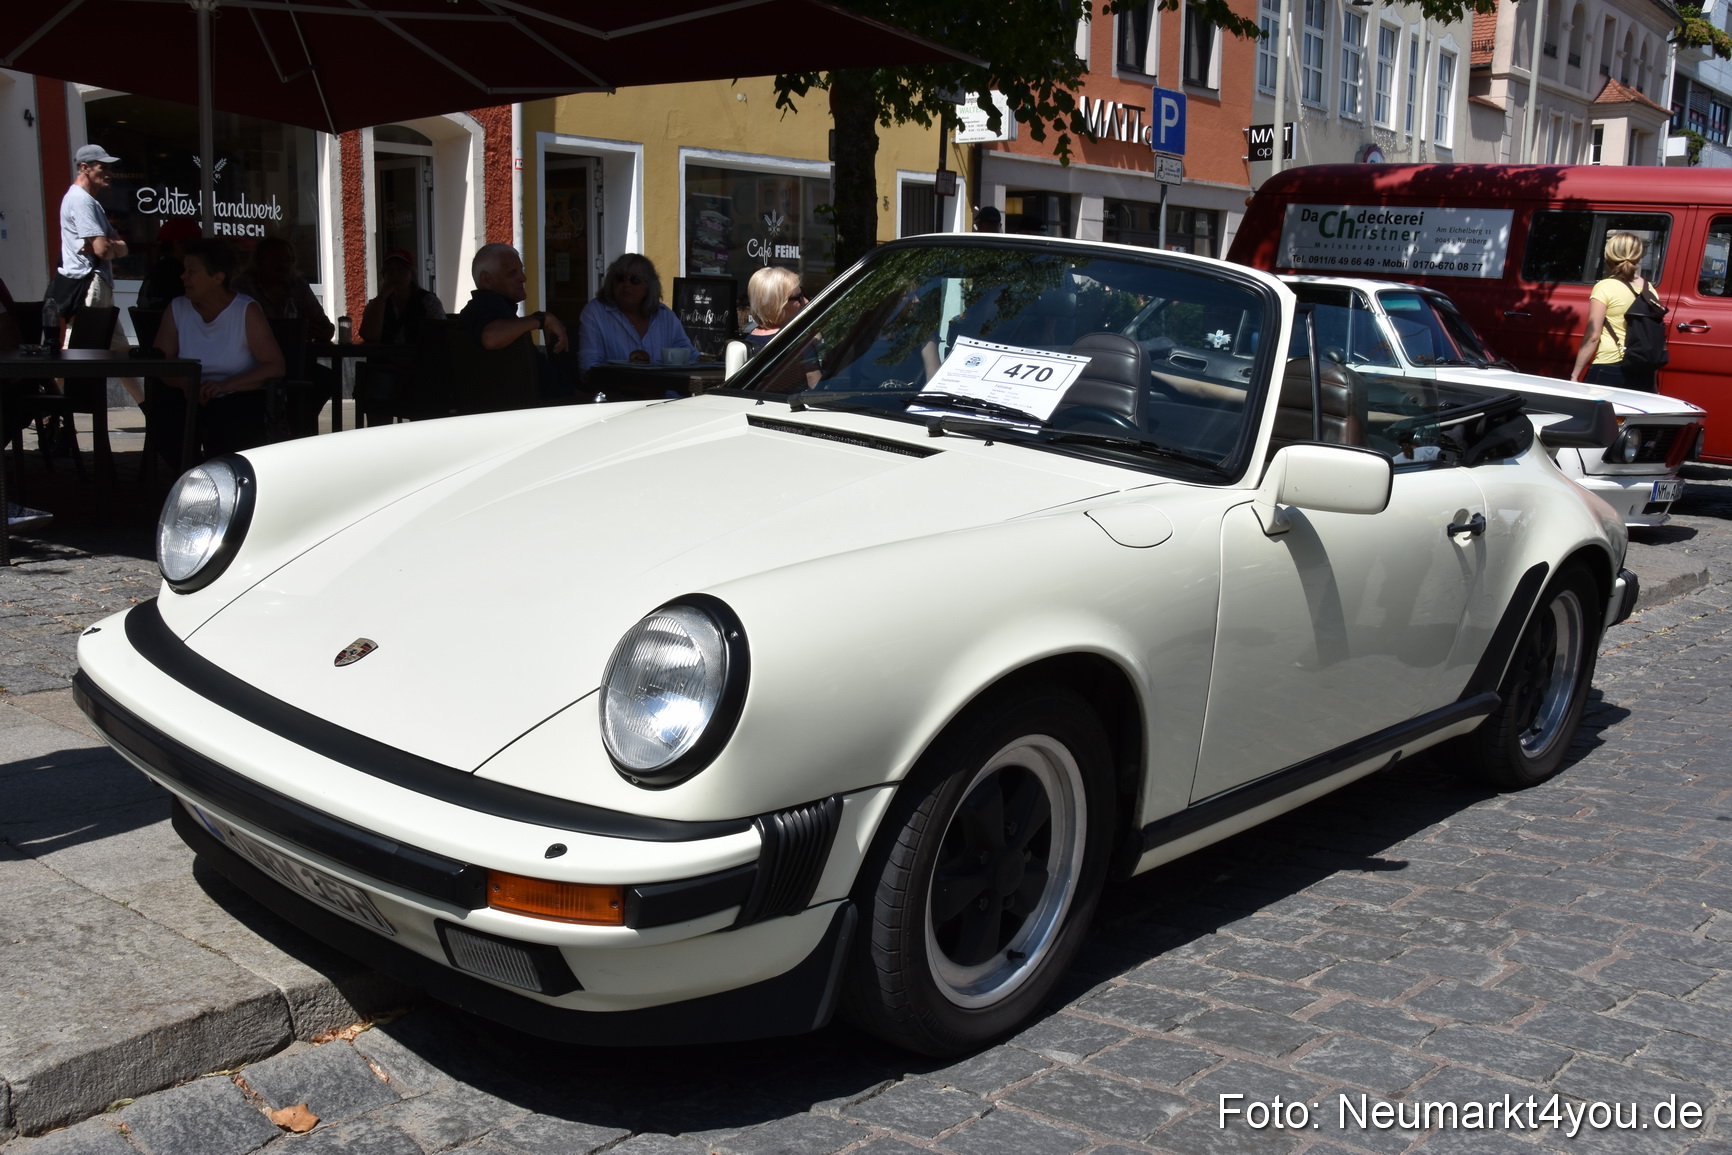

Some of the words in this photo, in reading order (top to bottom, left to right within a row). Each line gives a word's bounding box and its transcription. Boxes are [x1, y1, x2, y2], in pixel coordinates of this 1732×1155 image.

[24, 109, 34, 127] 4
[1080, 95, 1146, 144] MATT
[1161, 97, 1179, 144] P
[1251, 126, 1292, 144] MAT
[136, 186, 198, 215] Echtes
[213, 222, 265, 238] FRISCH
[1449, 226, 1482, 236] Eichelberg
[747, 238, 773, 267] Café
[1292, 254, 1306, 264] Tel.
[1308, 255, 1336, 265] 0911/6
[1338, 257, 1348, 266] 49
[1351, 257, 1361, 266] 66
[1364, 258, 1375, 267] 49
[1382, 259, 1408, 268] Mobil
[1412, 260, 1455, 270] 0170-670
[1457, 261, 1469, 271] 08
[1471, 262, 1483, 271] 77
[1004, 363, 1054, 383] 470
